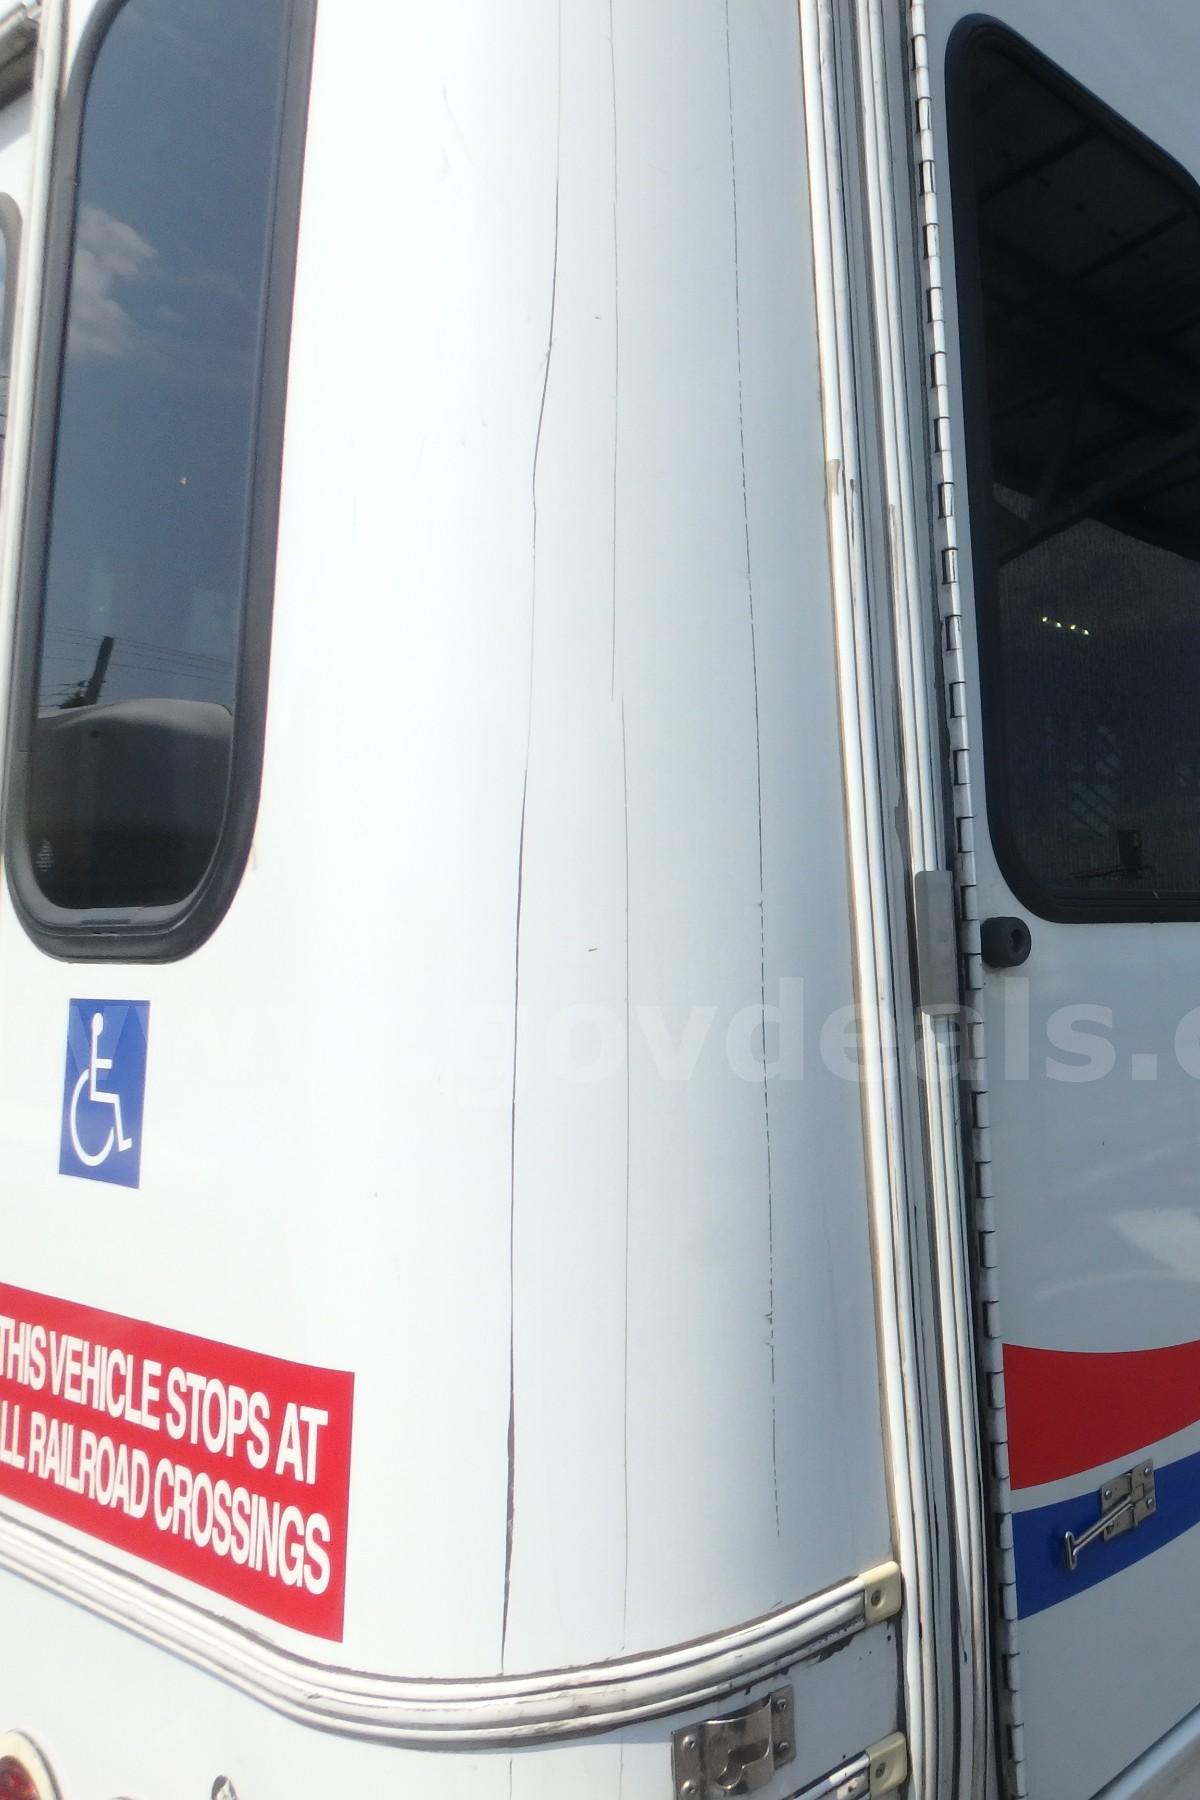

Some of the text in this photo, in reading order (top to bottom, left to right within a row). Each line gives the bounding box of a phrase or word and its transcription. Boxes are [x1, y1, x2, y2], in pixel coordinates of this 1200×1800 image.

[0, 1315, 328, 1484] THIS VEHICLE STOPS AT
[0, 1399, 331, 1594] LL RAILROAD CROSSINGS
